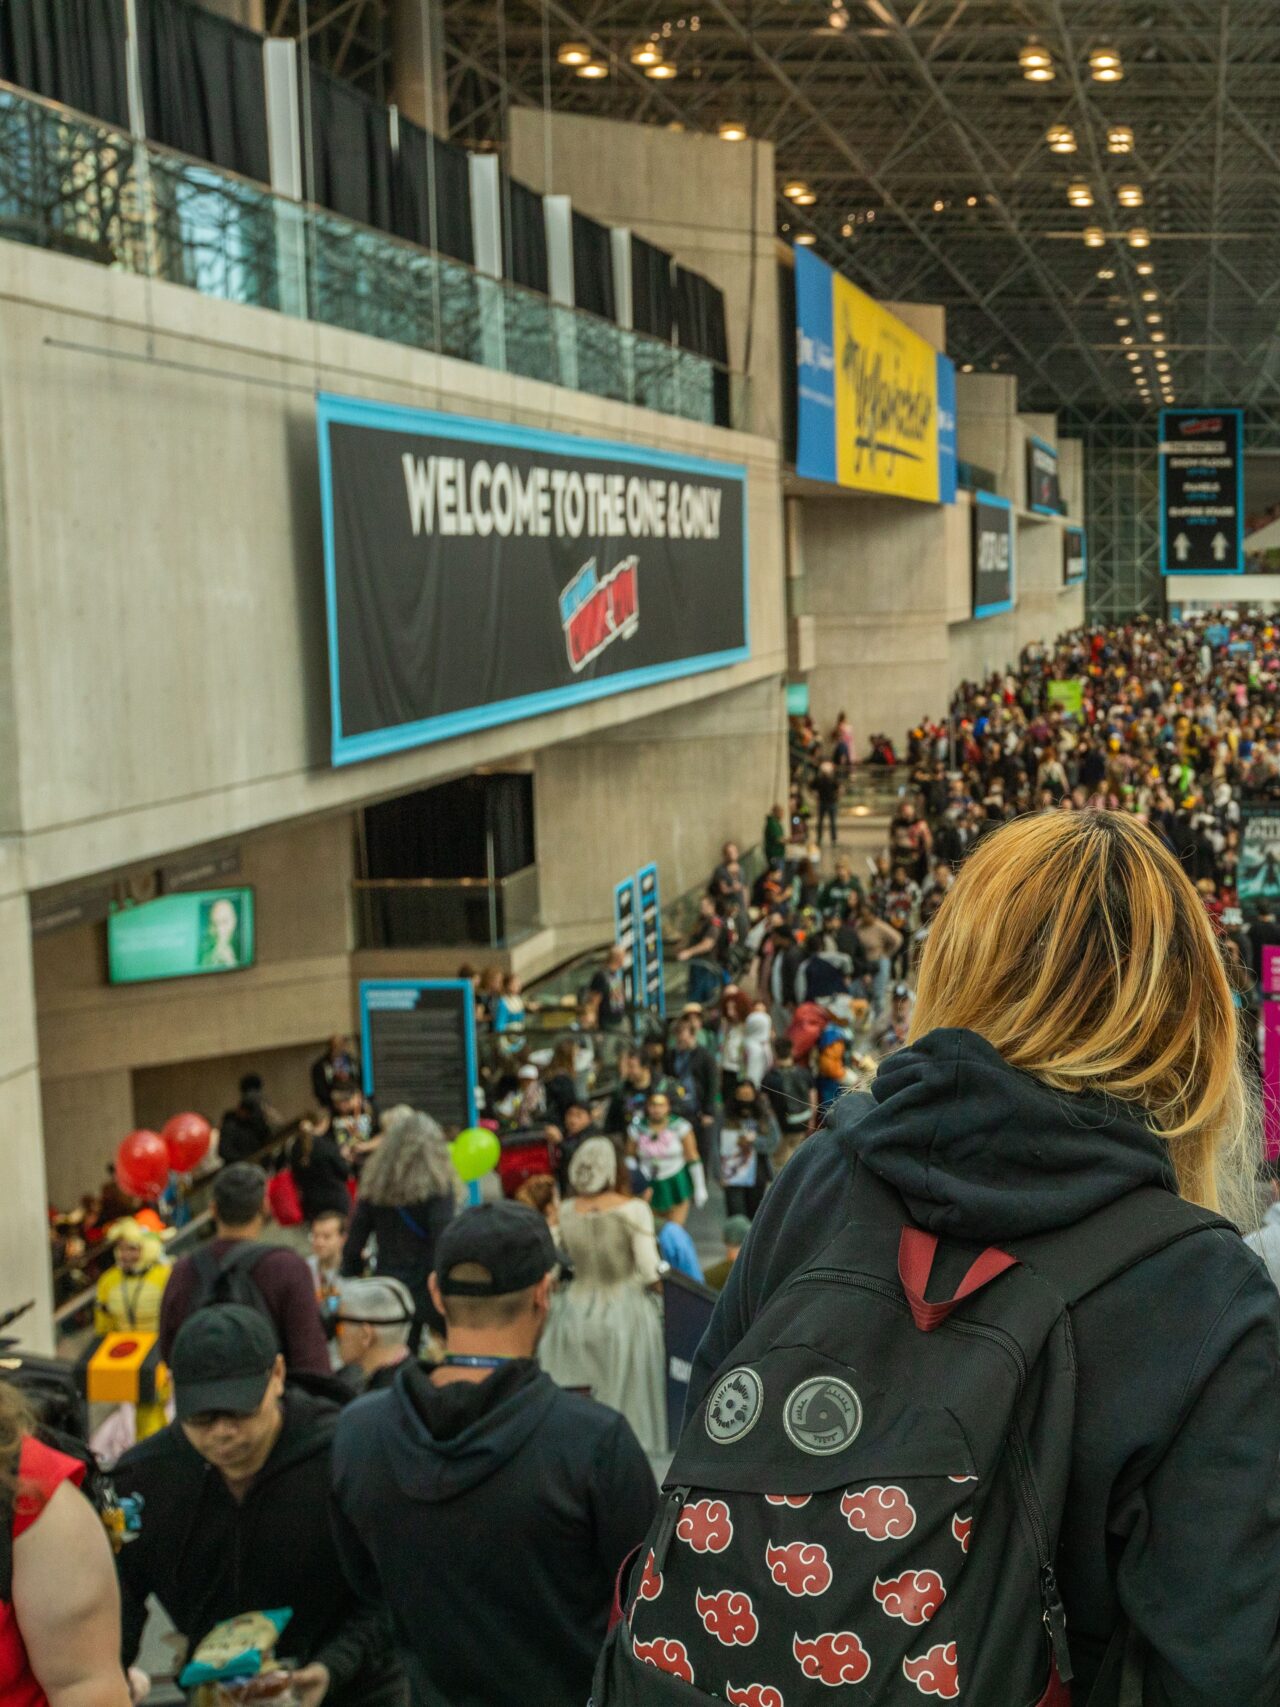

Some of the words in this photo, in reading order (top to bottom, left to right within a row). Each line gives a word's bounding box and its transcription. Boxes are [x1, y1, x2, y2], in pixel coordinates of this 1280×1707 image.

[401, 452, 551, 537] WELCOME
[551, 469, 585, 538] TO
[584, 472, 627, 537] THE
[626, 476, 666, 538] ONE
[667, 480, 681, 539] &
[681, 484, 722, 539] ONLY
